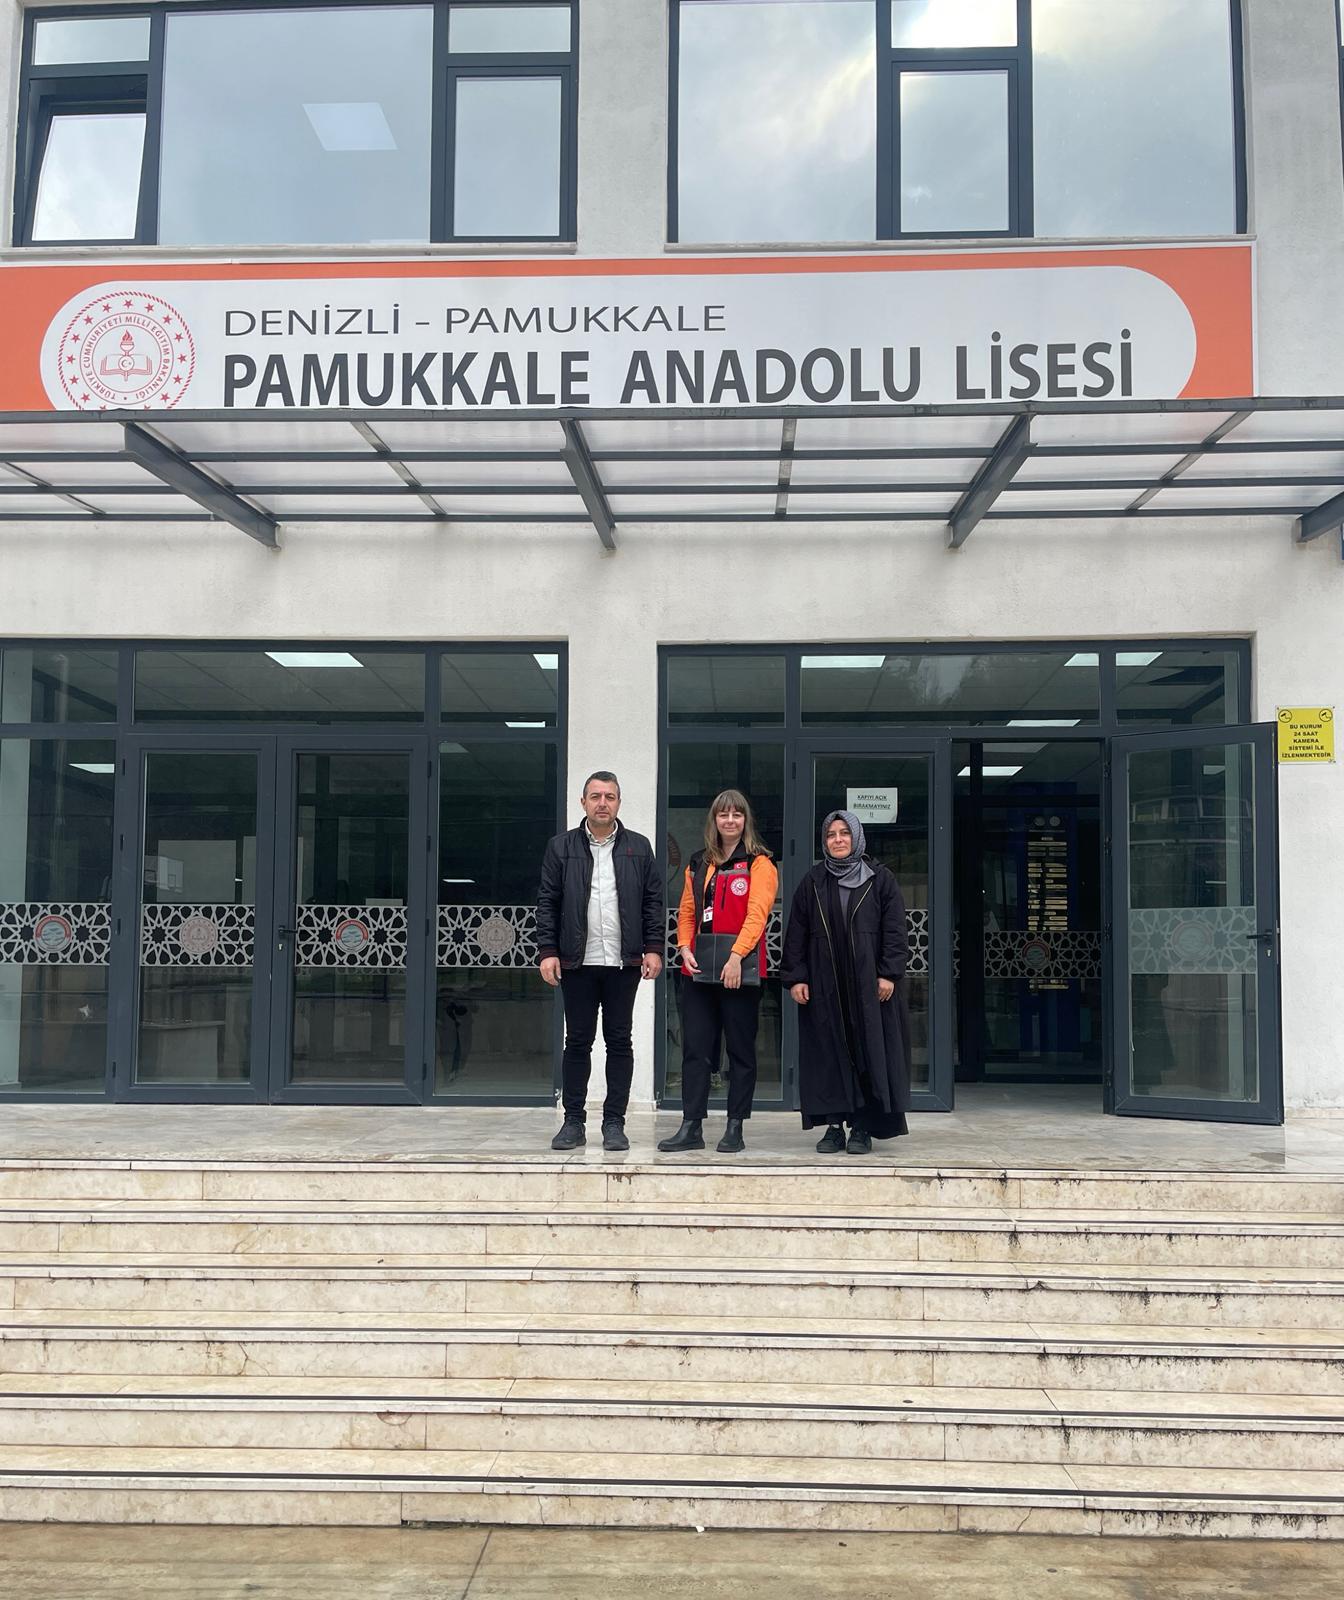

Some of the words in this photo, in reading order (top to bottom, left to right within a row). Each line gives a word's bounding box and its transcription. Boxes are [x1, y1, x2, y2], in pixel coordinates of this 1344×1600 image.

[125, 315, 151, 328] MİLLİ
[224, 303, 400, 337] DENİZLİ
[446, 304, 727, 335] PAMUKKALE
[84, 315, 122, 370] CUMHURİYETİ
[150, 325, 171, 356] EĞİTİM
[84, 369, 117, 401] TÜRKİYE
[135, 357, 171, 401] BAKANLIĞI
[223, 351, 591, 408] PAMUKKALE
[619, 345, 922, 404] ANADOLU
[956, 328, 1133, 400] LİSESİ
